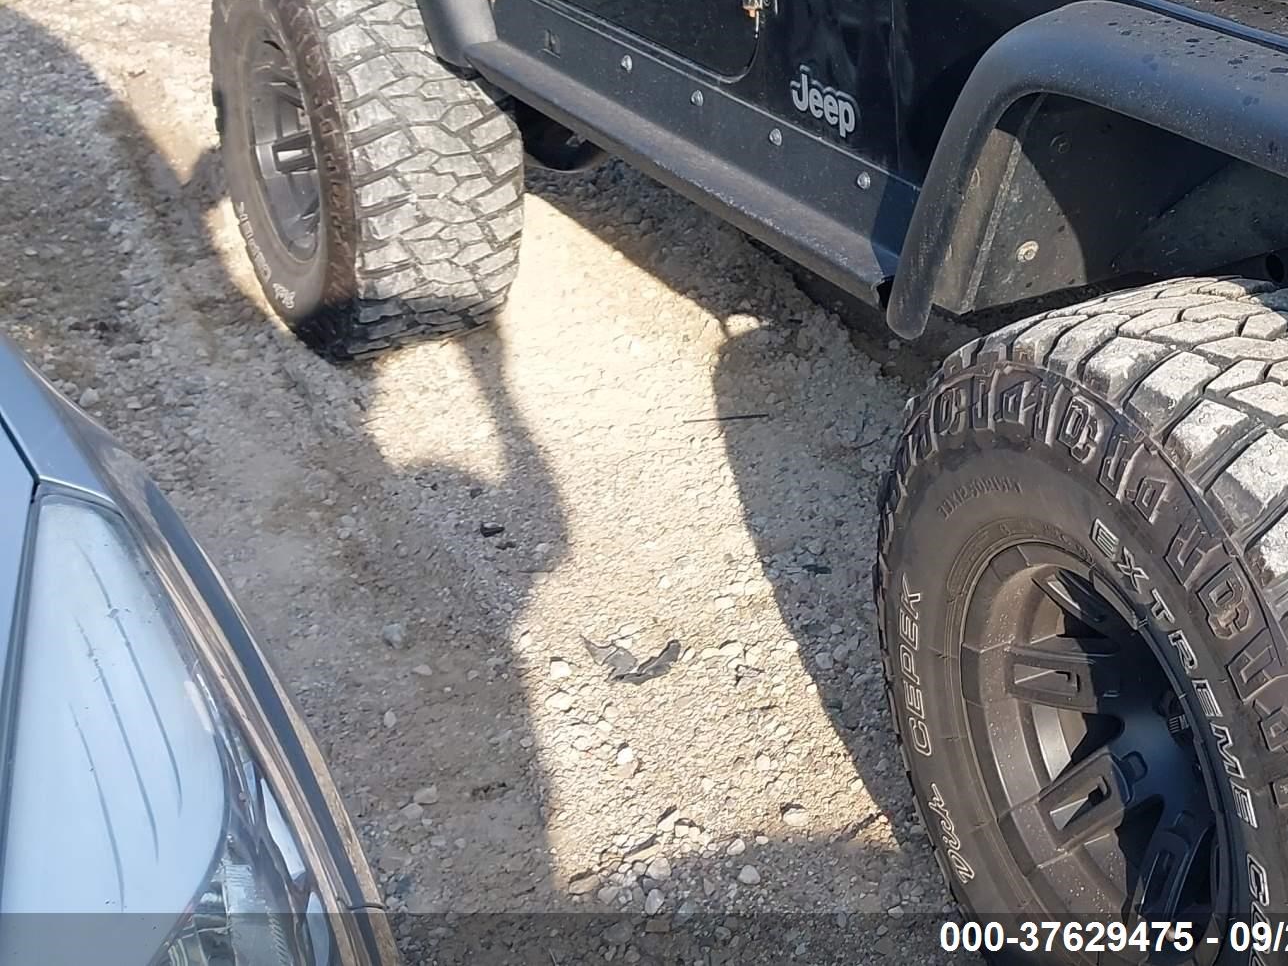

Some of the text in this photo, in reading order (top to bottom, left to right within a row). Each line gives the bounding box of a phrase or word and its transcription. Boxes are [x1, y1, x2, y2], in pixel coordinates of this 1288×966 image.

[790, 64, 860, 138] Jeep
[900, 571, 976, 884] Dick CEPEK
[1090, 518, 1259, 829] EXTREME
